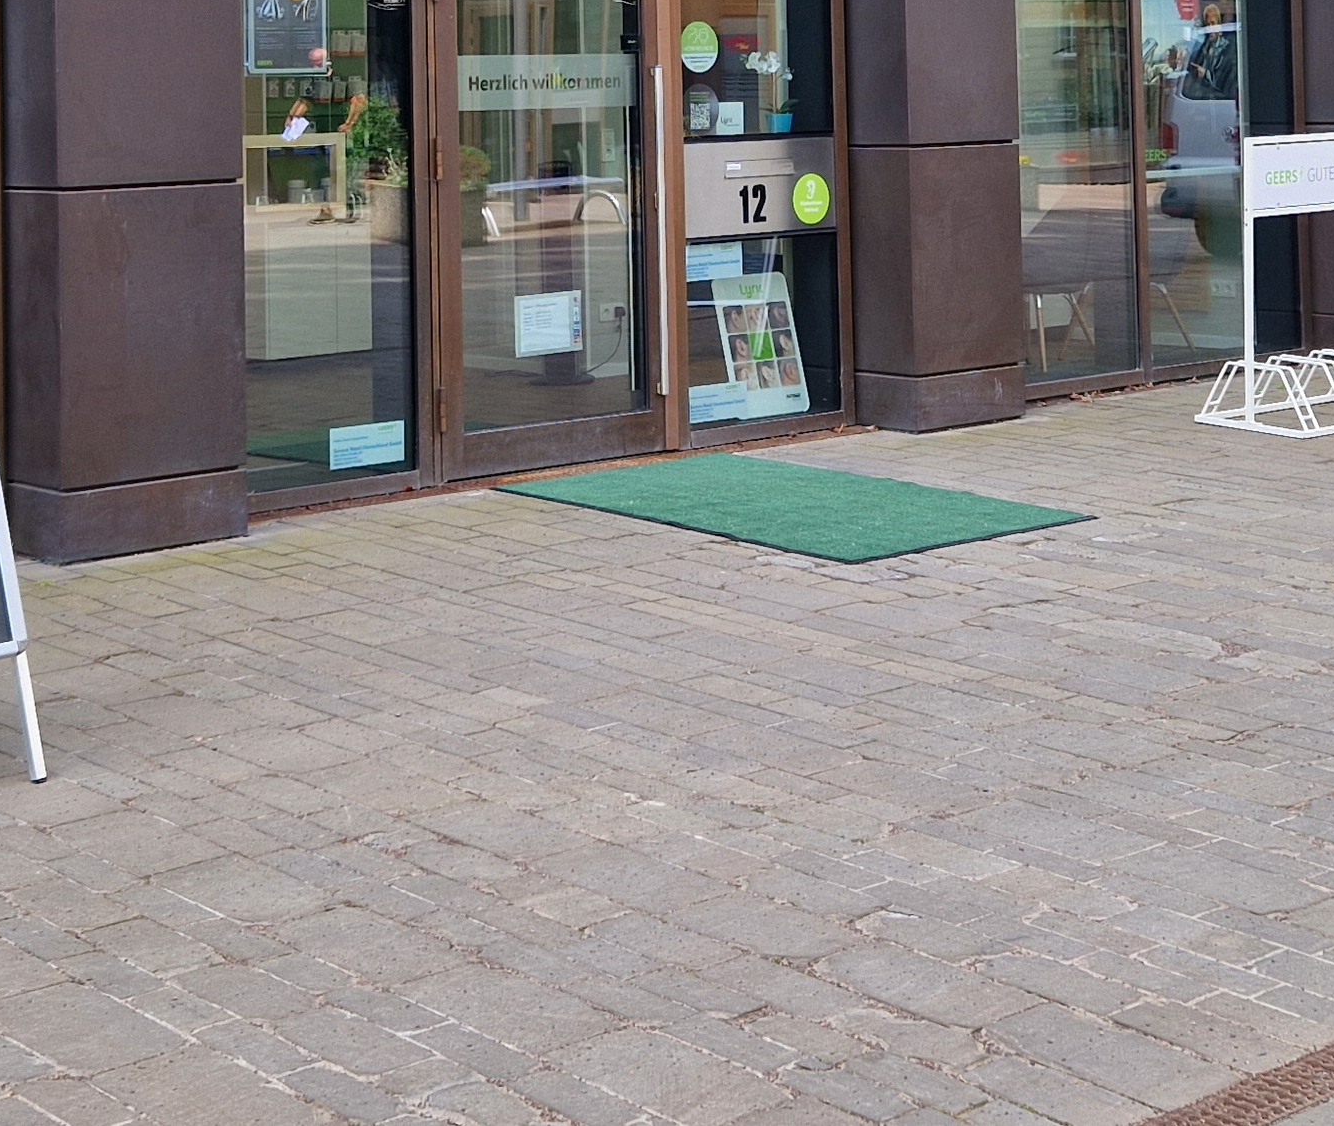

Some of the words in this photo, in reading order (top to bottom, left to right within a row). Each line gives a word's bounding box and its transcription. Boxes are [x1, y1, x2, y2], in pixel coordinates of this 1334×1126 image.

[468, 74, 528, 92] Herzlich
[533, 73, 621, 91] willkommen
[1265, 168, 1299, 185] GEERS
[739, 183, 767, 224] 12
